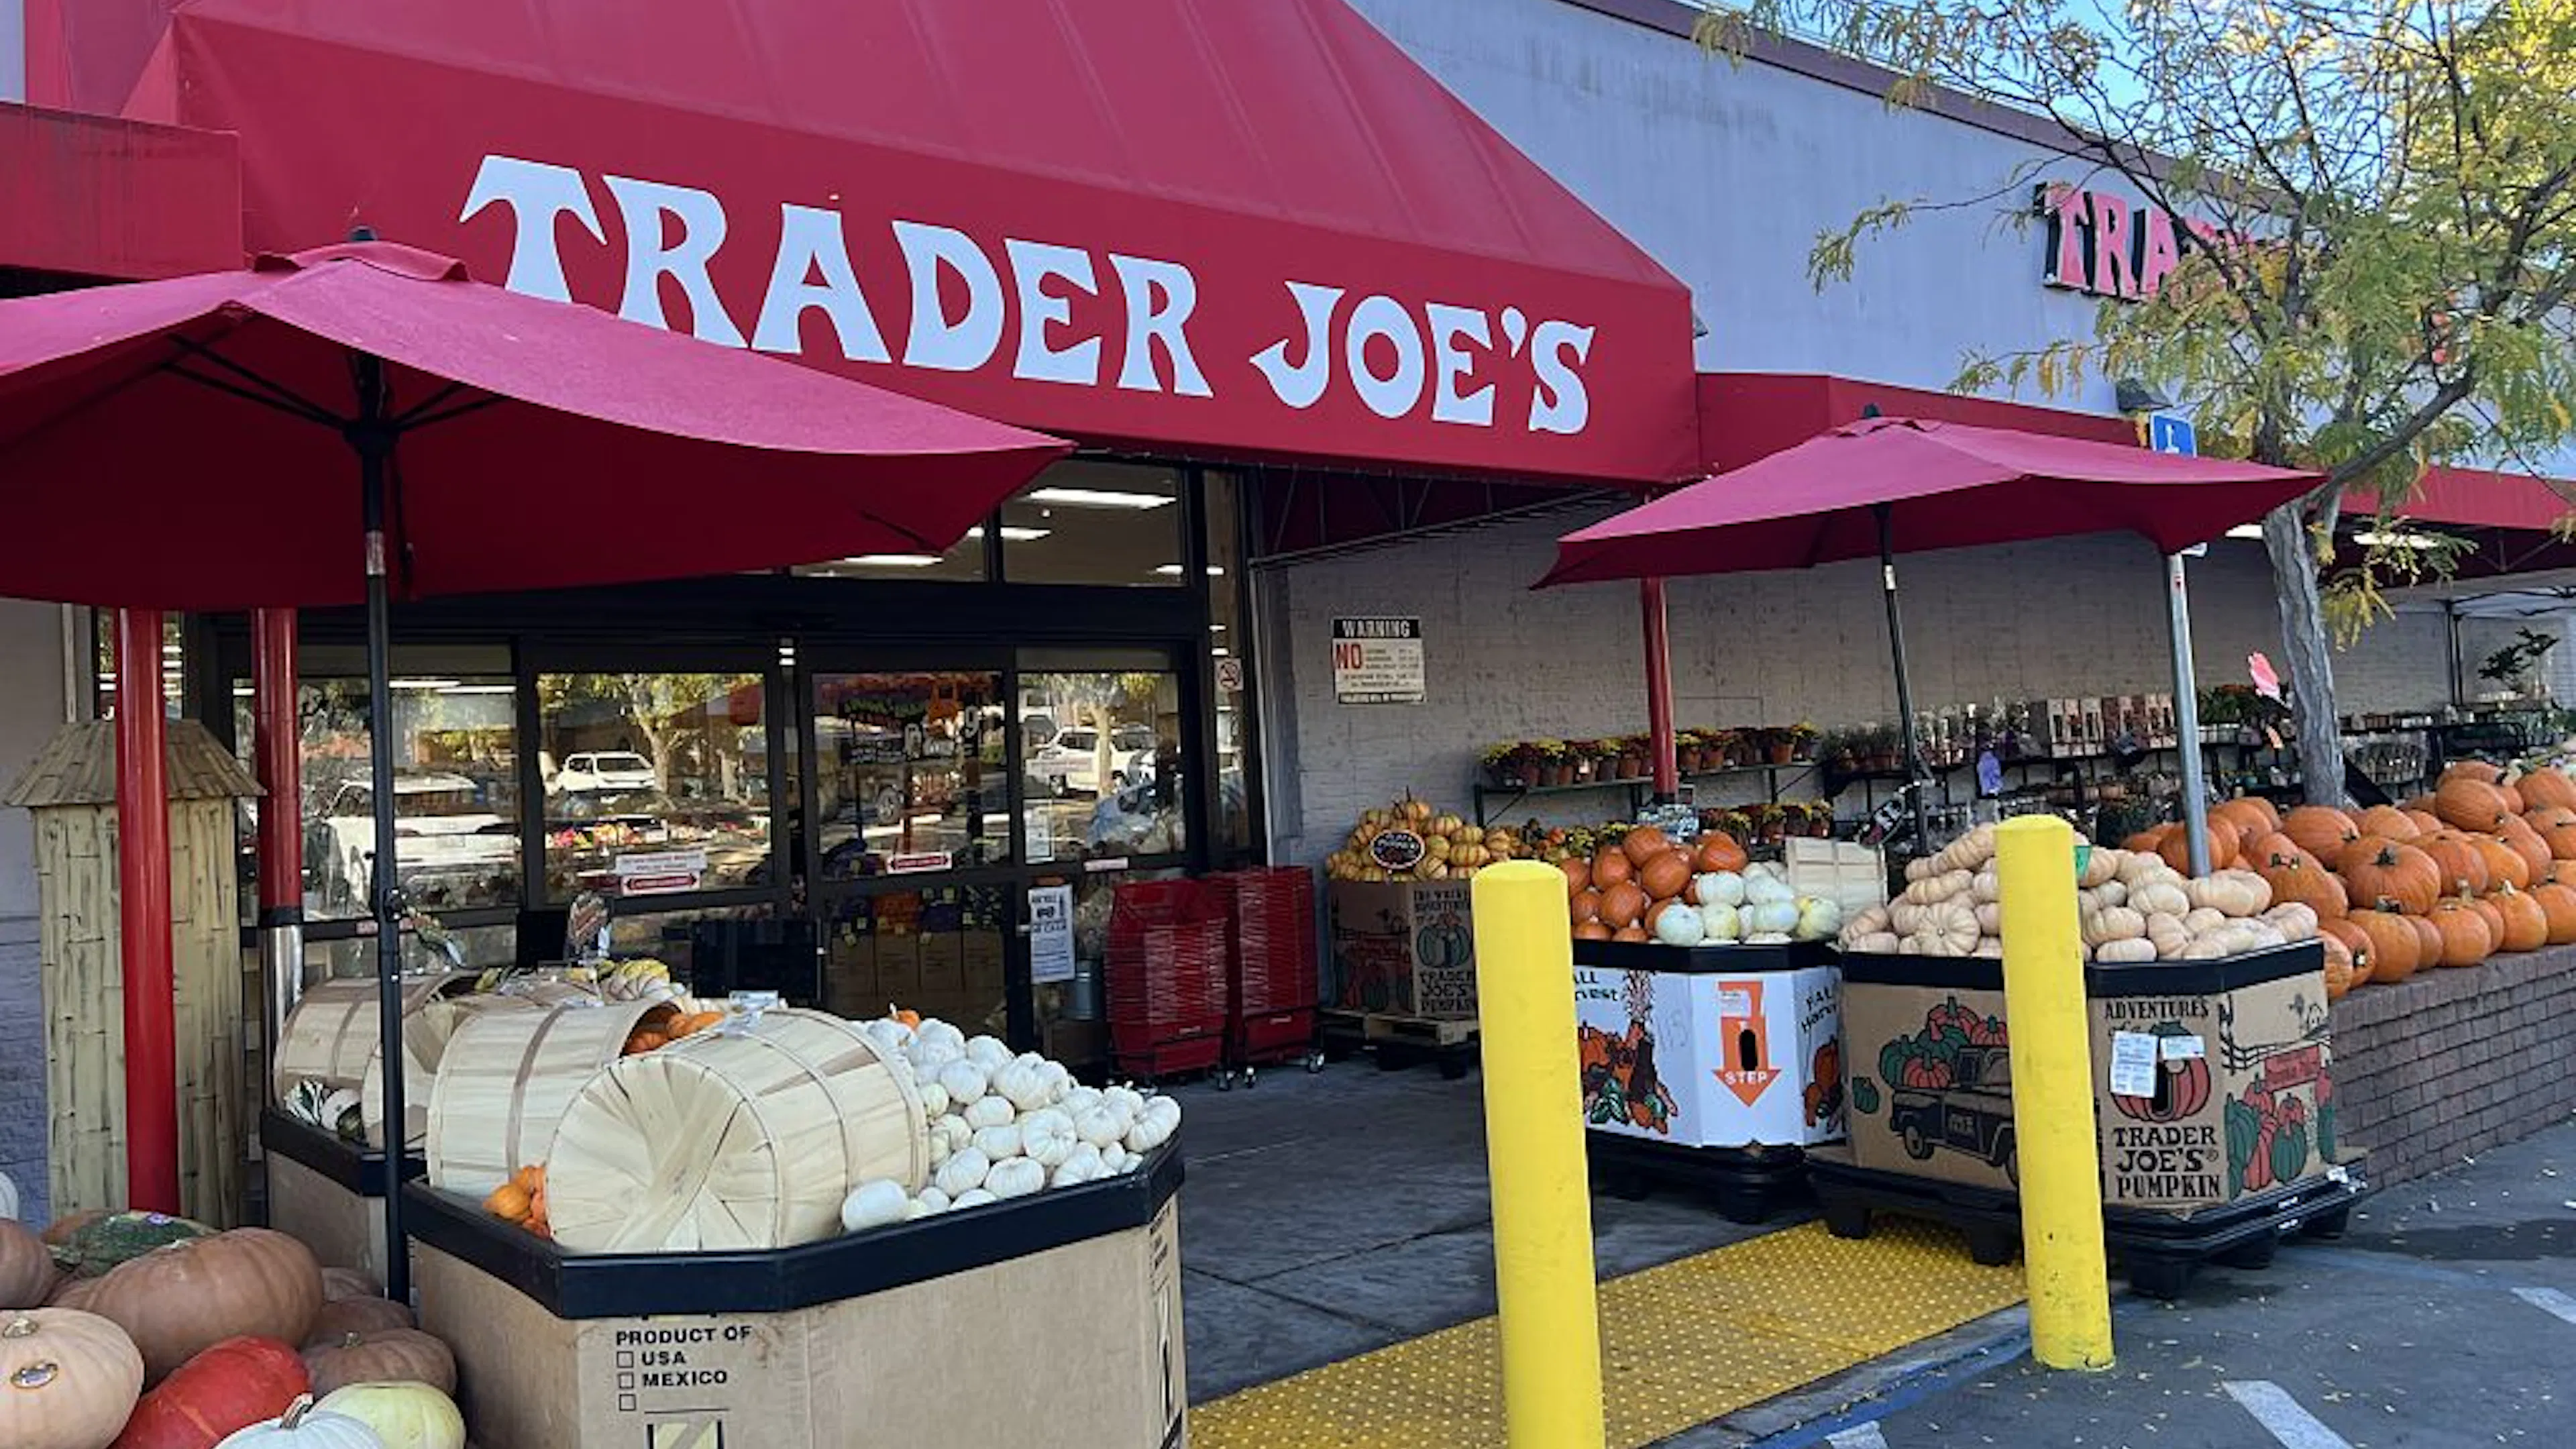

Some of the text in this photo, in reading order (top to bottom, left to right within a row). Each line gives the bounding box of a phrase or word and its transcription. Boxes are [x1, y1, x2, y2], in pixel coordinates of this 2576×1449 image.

[459, 154, 1596, 435] TRADER JOE'S
[1342, 620, 1410, 638] WARNING
[1336, 643, 1362, 669] NO
[2105, 1000, 2209, 1020] ADVENTURES
[1724, 1070, 1768, 1085] STEP
[2114, 1126, 2216, 1147] TRADER
[2117, 1175, 2220, 1198] PUMPKIN
[616, 1325, 752, 1346] PRODUCT OF
[641, 1350, 687, 1366] USA
[643, 1370, 728, 1387] MEXICO
